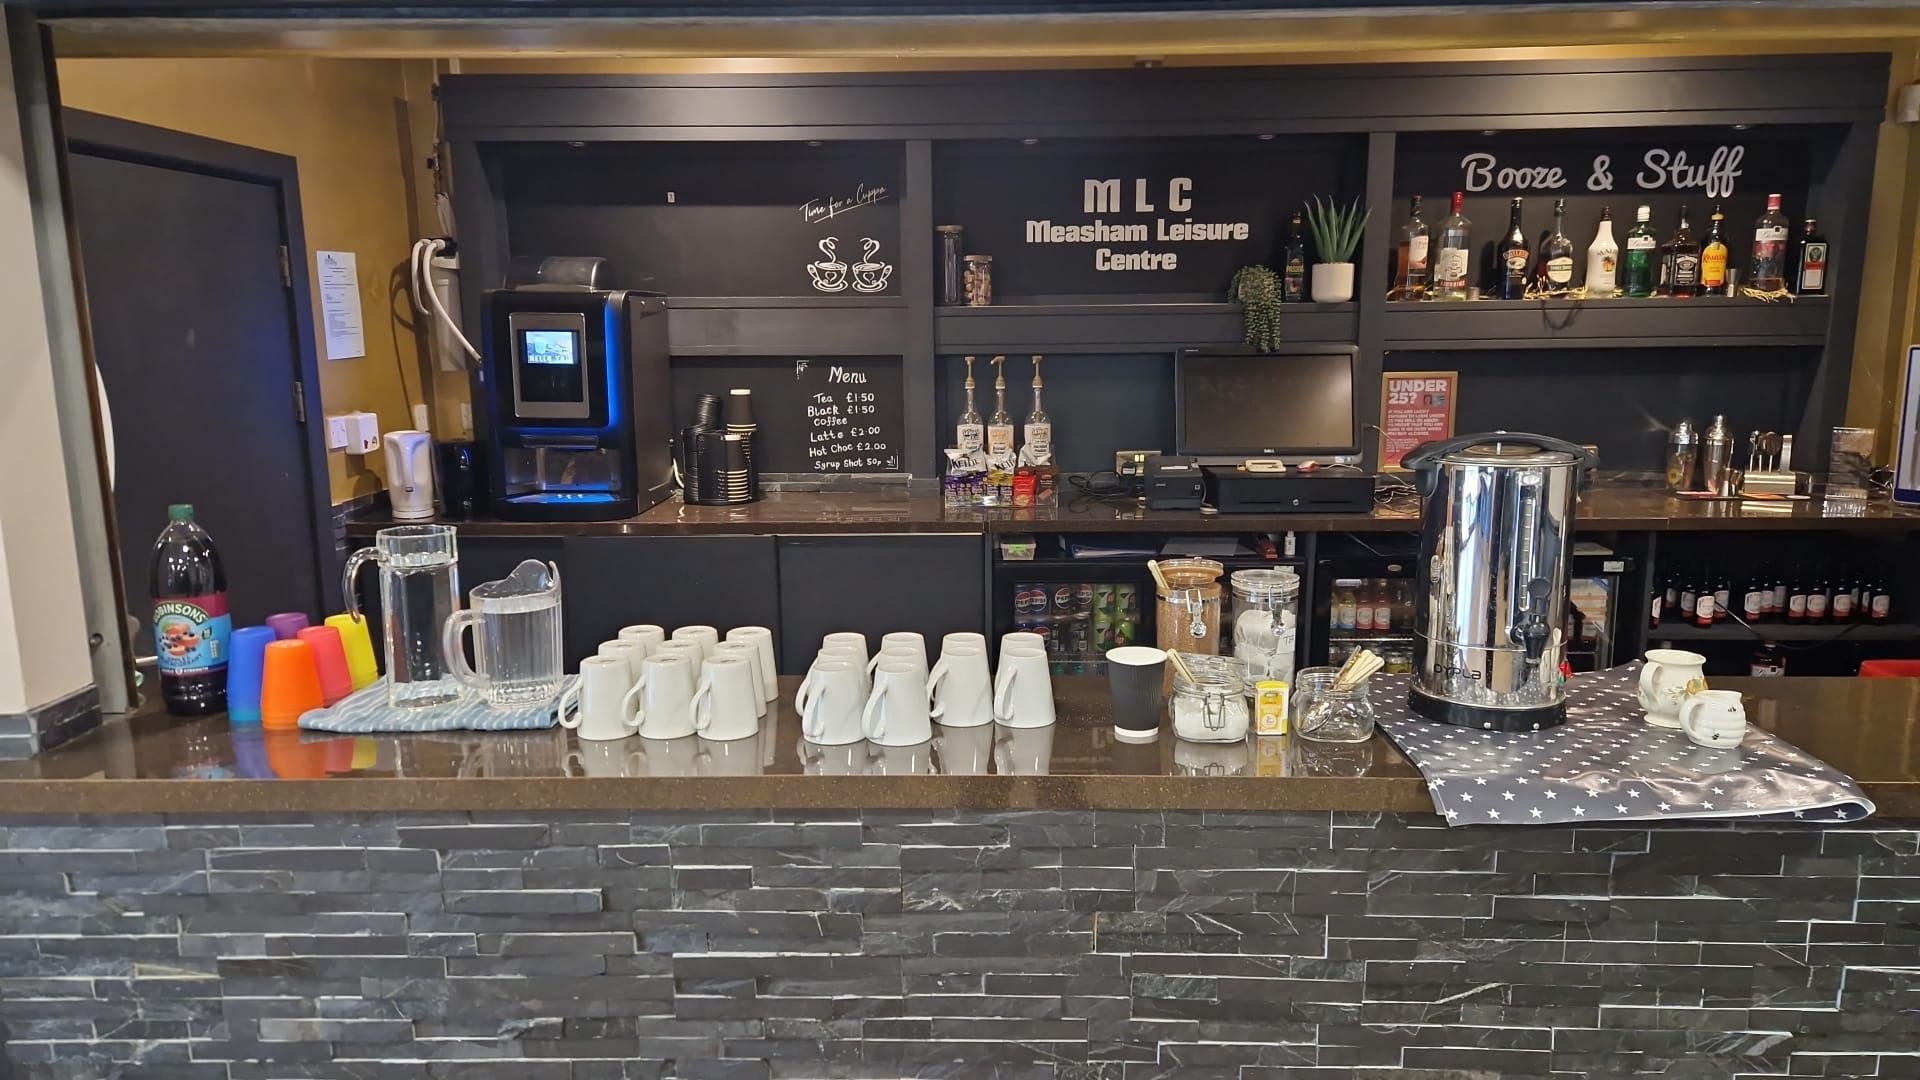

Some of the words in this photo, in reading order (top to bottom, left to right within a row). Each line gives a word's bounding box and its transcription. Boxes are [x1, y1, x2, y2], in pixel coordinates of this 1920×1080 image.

[1461, 152, 1567, 191] Booze
[1586, 154, 1613, 191] &
[1636, 146, 1745, 198] Stuff
[798, 198, 826, 222] Time
[829, 196, 843, 219] for
[856, 182, 886, 204] Cuppa
[1026, 219, 1148, 243] Measham
[1157, 217, 1249, 241] Leisure
[1096, 248, 1177, 271] Centre
[828, 366, 867, 384] Menu
[1389, 379, 1447, 392] UNDER
[812, 392, 833, 404] Tea
[1388, 392, 1418, 405] 25?
[807, 404, 840, 417] Black
[810, 430, 844, 443] Latte
[809, 446, 828, 457] Hot
[830, 442, 854, 454] Choc
[856, 442, 887, 451] £2.00
[814, 460, 841, 471] Syrup
[843, 457, 863, 468] Shot
[866, 458, 882, 466] 50p
